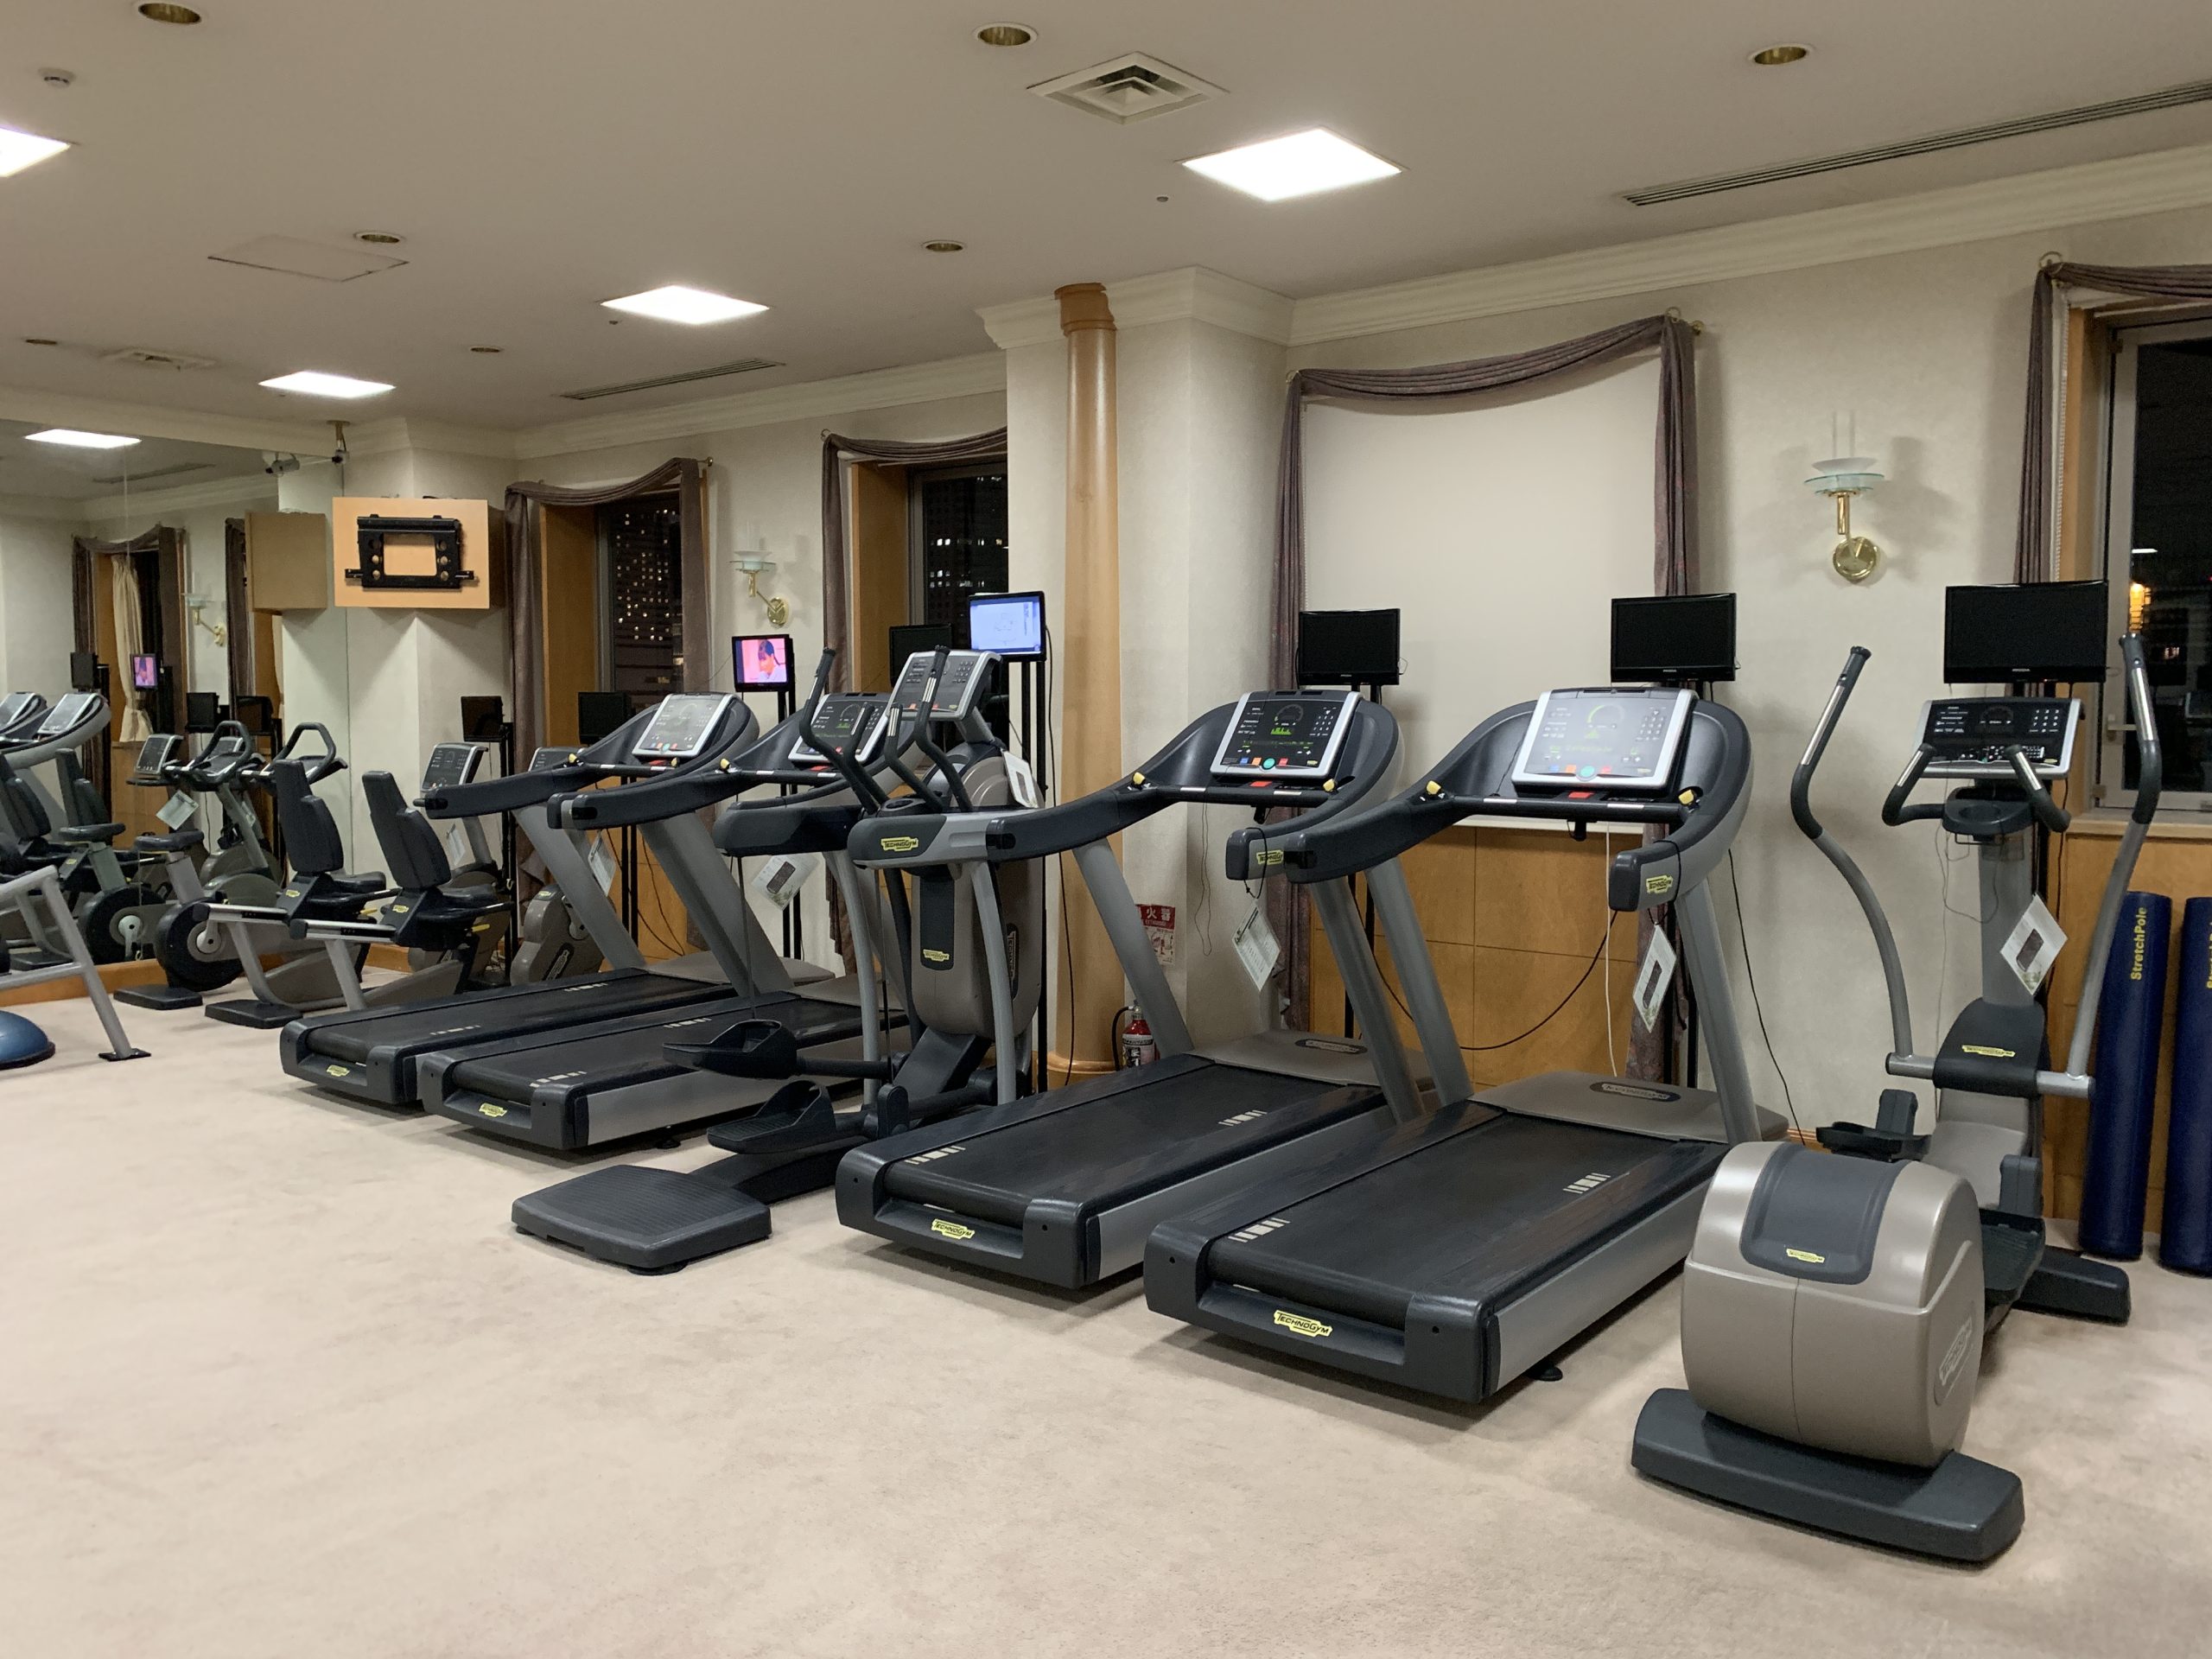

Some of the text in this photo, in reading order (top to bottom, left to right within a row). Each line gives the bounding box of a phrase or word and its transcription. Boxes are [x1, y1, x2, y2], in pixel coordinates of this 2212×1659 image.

[2130, 907, 2147, 981] StretchPole
[934, 1220, 972, 1236] TECHNOGYM
[1277, 1312, 1329, 1333] TECHNOGYM
